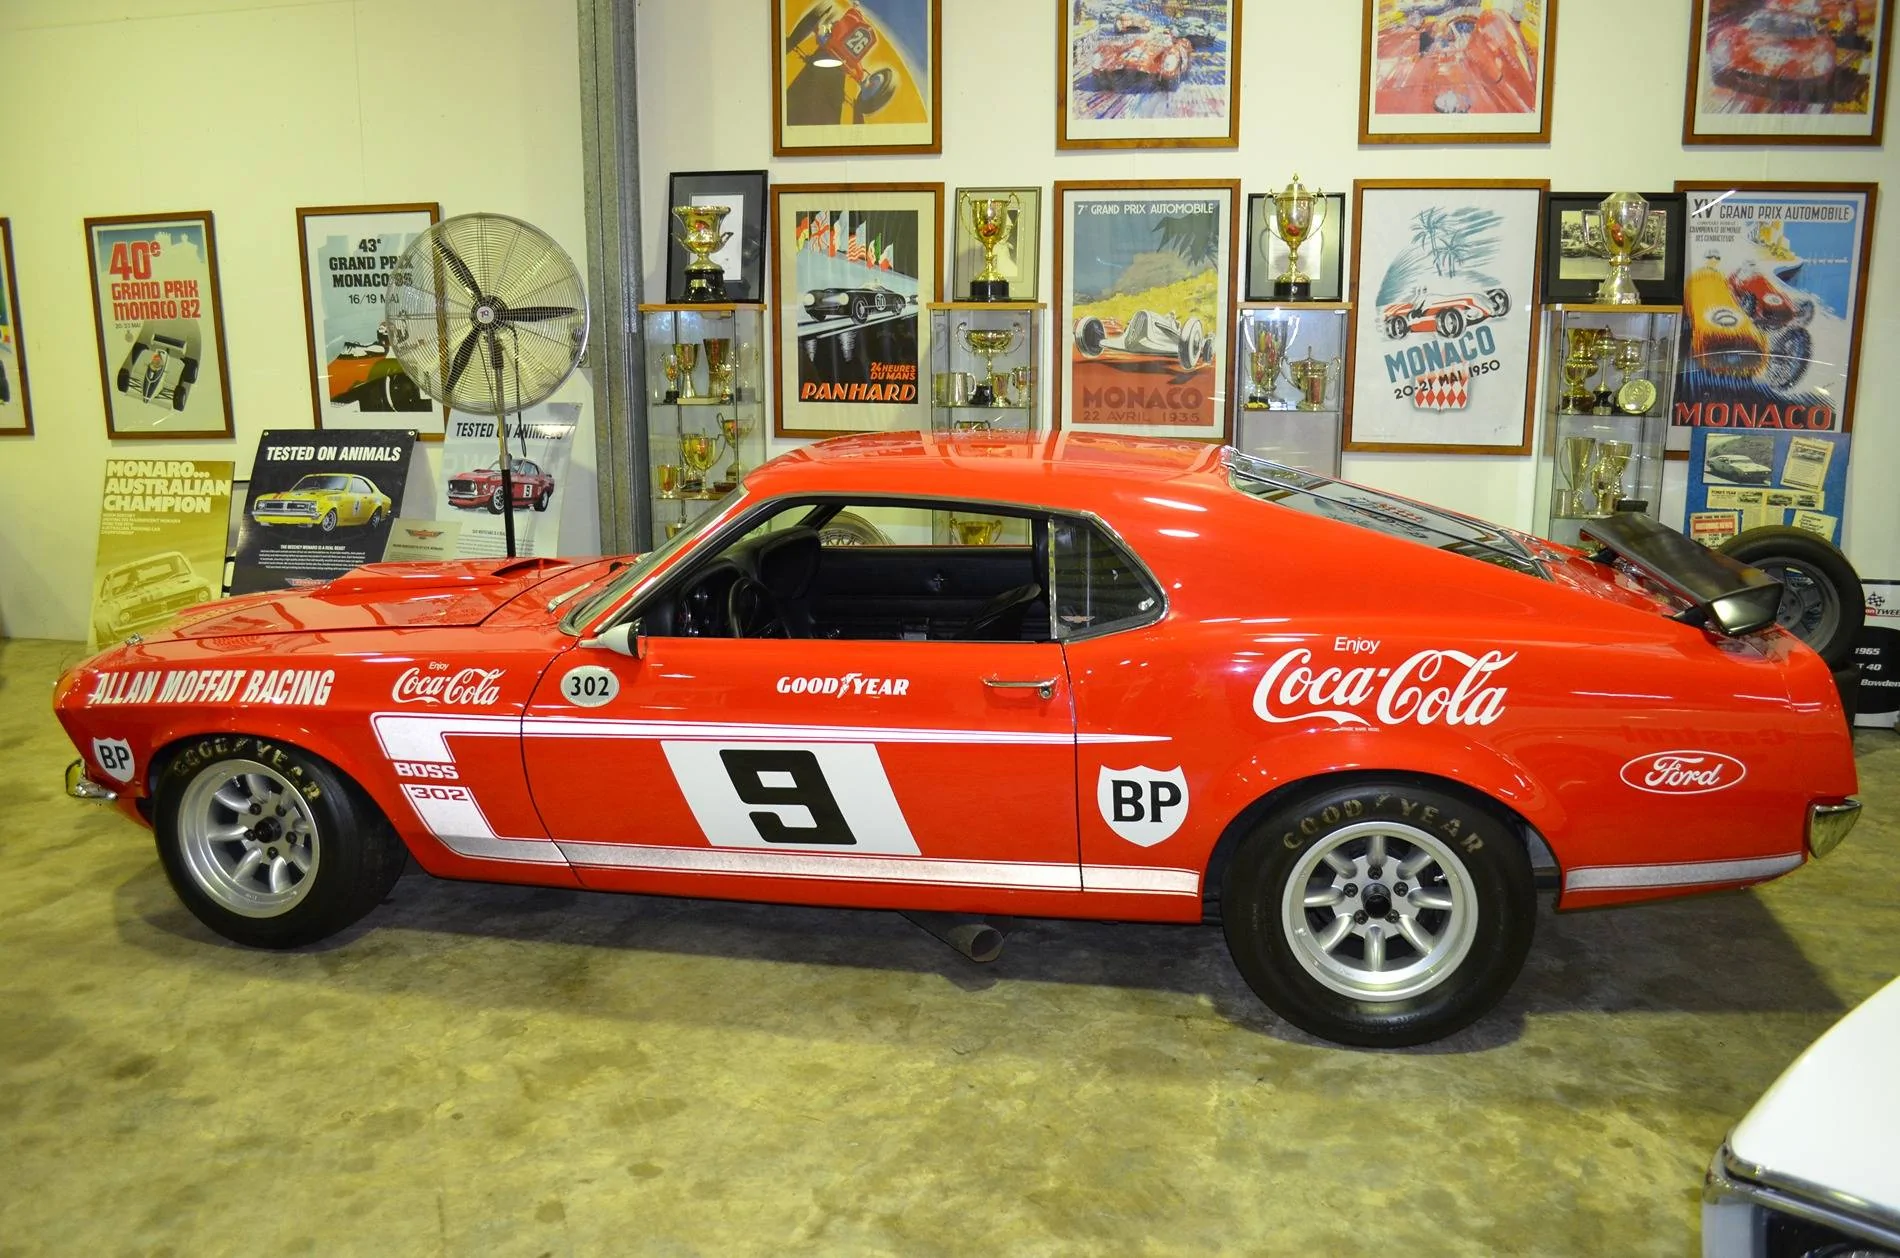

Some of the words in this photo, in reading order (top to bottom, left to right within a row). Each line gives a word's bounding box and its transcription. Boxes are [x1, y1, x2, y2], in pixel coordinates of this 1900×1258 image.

[845, 30, 869, 54] 26
[1091, 204, 1119, 215] GRAND
[1124, 203, 1146, 214] PRIX
[1150, 203, 1214, 214] AUTOMOBILE
[1719, 205, 1754, 219] GRAND
[1758, 206, 1782, 220] PRIX
[1784, 206, 1850, 221] AUTOMOBILE
[329, 256, 376, 270] GRAND
[332, 272, 389, 288] MONACO
[111, 281, 160, 300] GRAND
[163, 280, 199, 299] PRIX
[348, 293, 377, 305] 16/19
[180, 299, 201, 319] 82
[1384, 325, 1496, 383] MONACO
[870, 372, 885, 380] DU
[886, 372, 916, 380] MANS
[881, 364, 916, 373] HEURES
[1438, 370, 1463, 386] MAI
[1468, 360, 1501, 378] 1950
[801, 382, 916, 401] PANHARD
[1083, 386, 1203, 410] MONACO
[1083, 411, 1100, 421] 22
[1107, 411, 1150, 422] AVRIL
[1674, 401, 1833, 430] MONACO
[456, 422, 494, 438] TESTED
[497, 423, 512, 438] N
[266, 446, 314, 461] TESTED
[317, 446, 338, 461] ON
[339, 446, 402, 462] ANIMALS
[106, 460, 211, 478] MONARO...
[104, 478, 231, 496] AUSTRALIAN
[103, 494, 212, 513] CHAMPION
[1333, 636, 1380, 655] Enjoy
[1855, 648, 1881, 656] 1965
[428, 661, 450, 671] Enjoy
[1866, 663, 1882, 671] 40
[88, 671, 162, 705] ALLAN
[156, 669, 247, 704] MOFFAT
[240, 669, 335, 706] RACING
[391, 667, 507, 706] Coca-Cola
[571, 676, 610, 696] 302
[1252, 648, 1518, 726] Coca-Cola
[99, 744, 130, 770] BP
[393, 762, 459, 780] BOSS
[1644, 756, 1723, 786] Ford
[410, 786, 468, 802] 302
[718, 749, 857, 845] 9
[1112, 778, 1182, 824] BP
